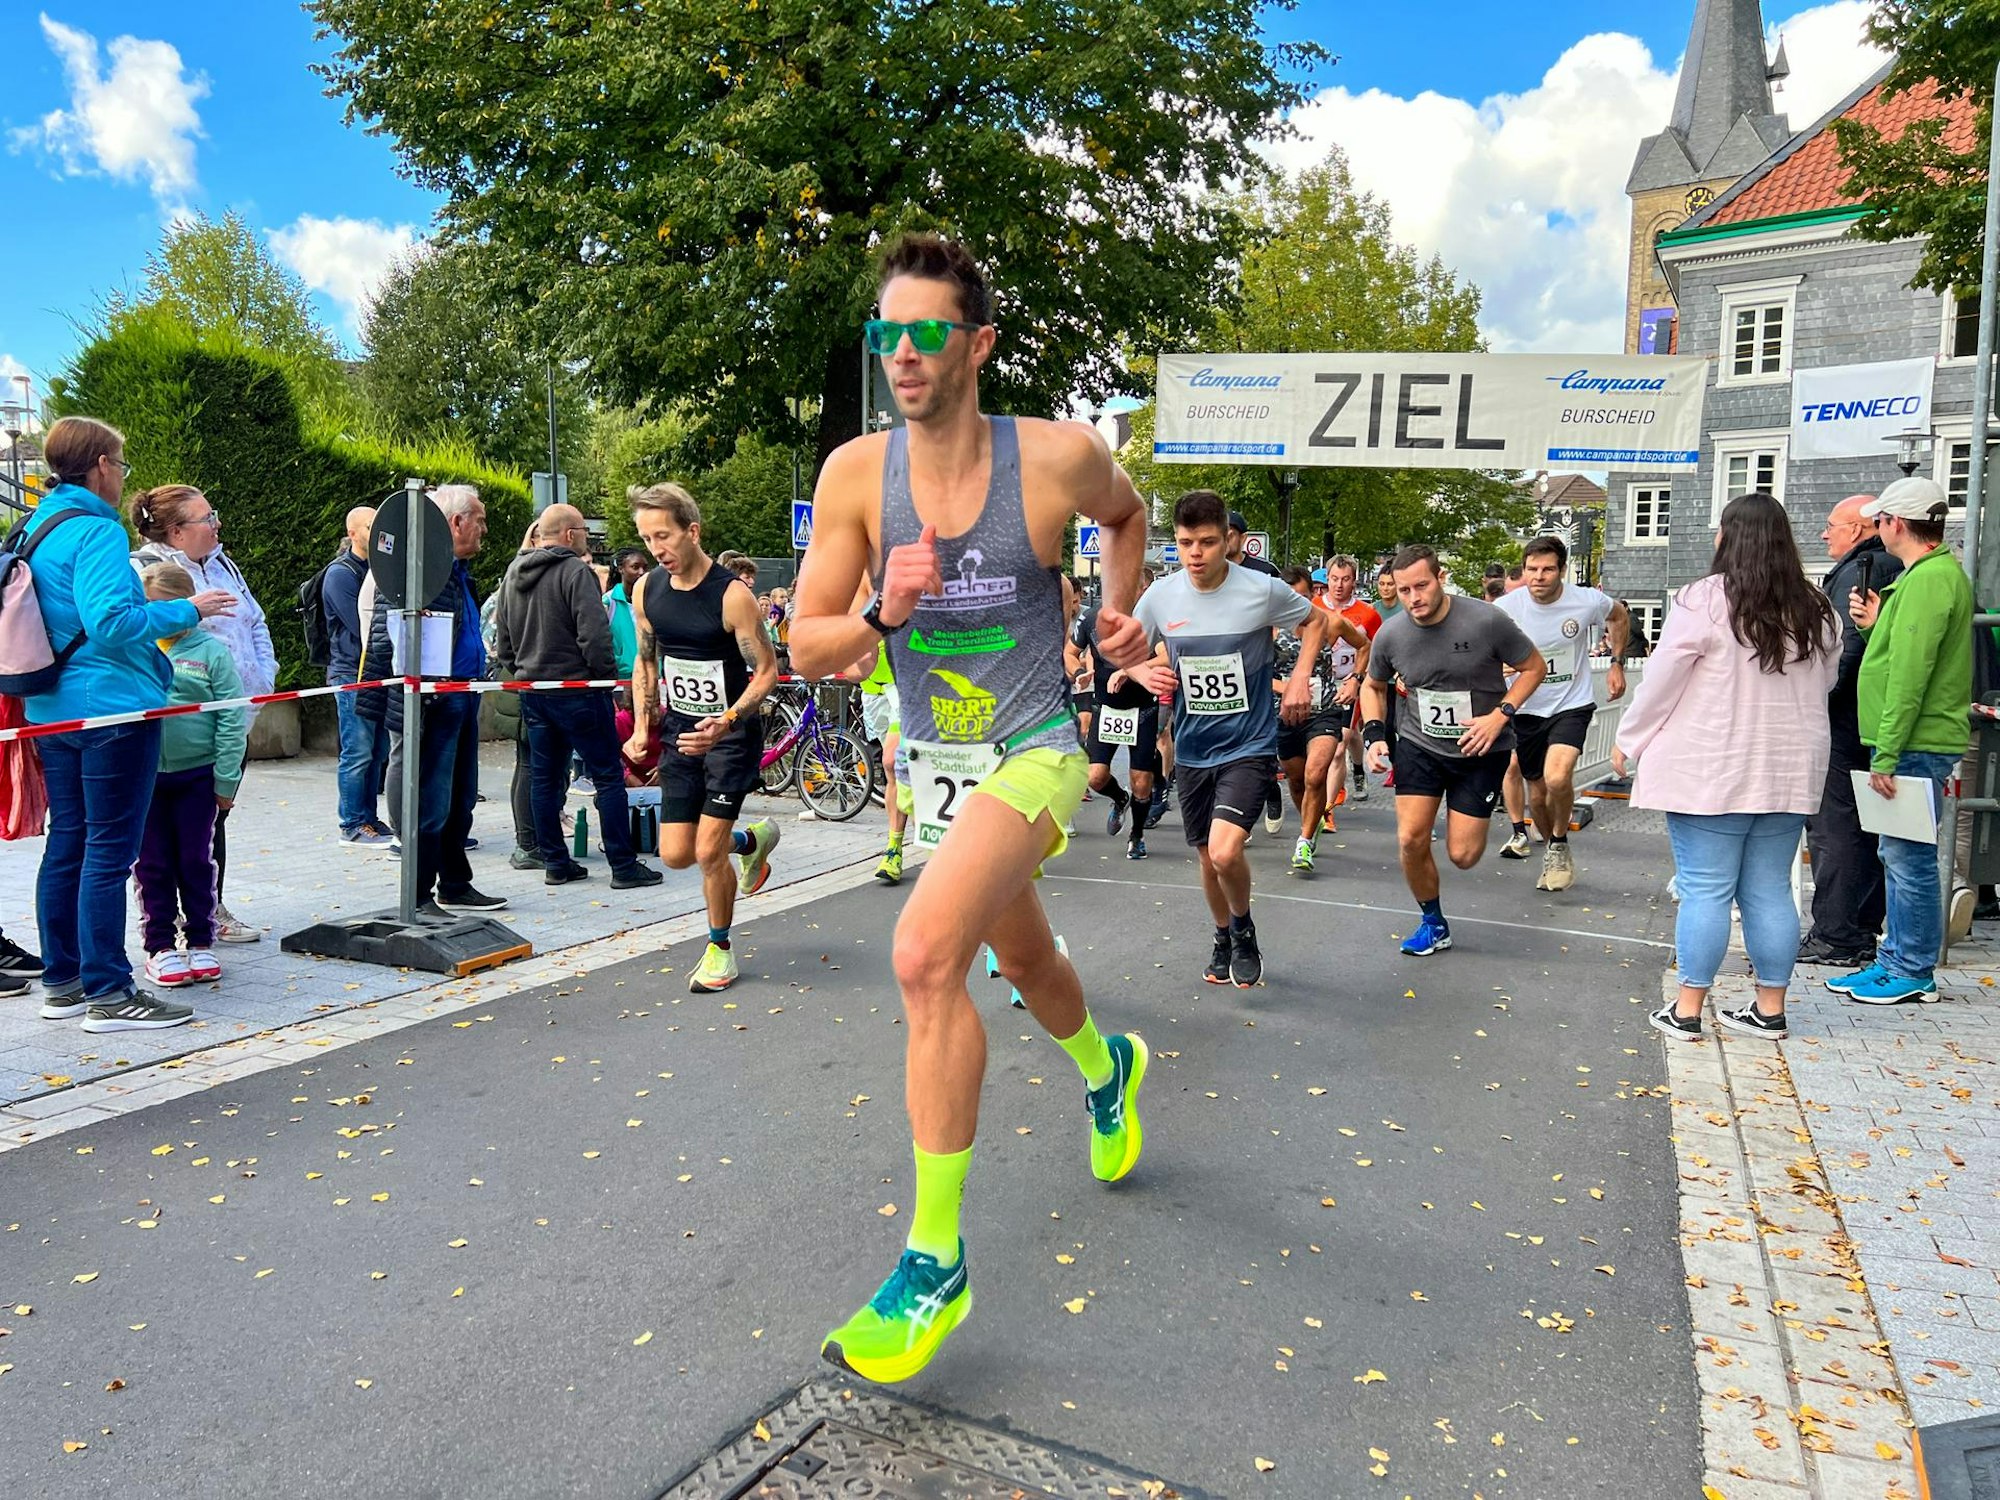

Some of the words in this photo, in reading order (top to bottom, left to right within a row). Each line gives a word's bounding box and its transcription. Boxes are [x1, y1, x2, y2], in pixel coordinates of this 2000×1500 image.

[1187, 405, 1270, 419] BURSCHEID
[1308, 373, 1506, 450] ZIEL
[1561, 409, 1656, 424] BURSCHEID
[1802, 396, 1921, 423] TENNECO
[1558, 451, 1687, 462] www.campanaradsport.de
[673, 676, 718, 703] 633
[1188, 673, 1239, 700] 585
[1430, 705, 1459, 727] 21
[1103, 717, 1133, 735] 589
[918, 749, 973, 760] urscheider
[931, 760, 988, 774] Stadtlauf
